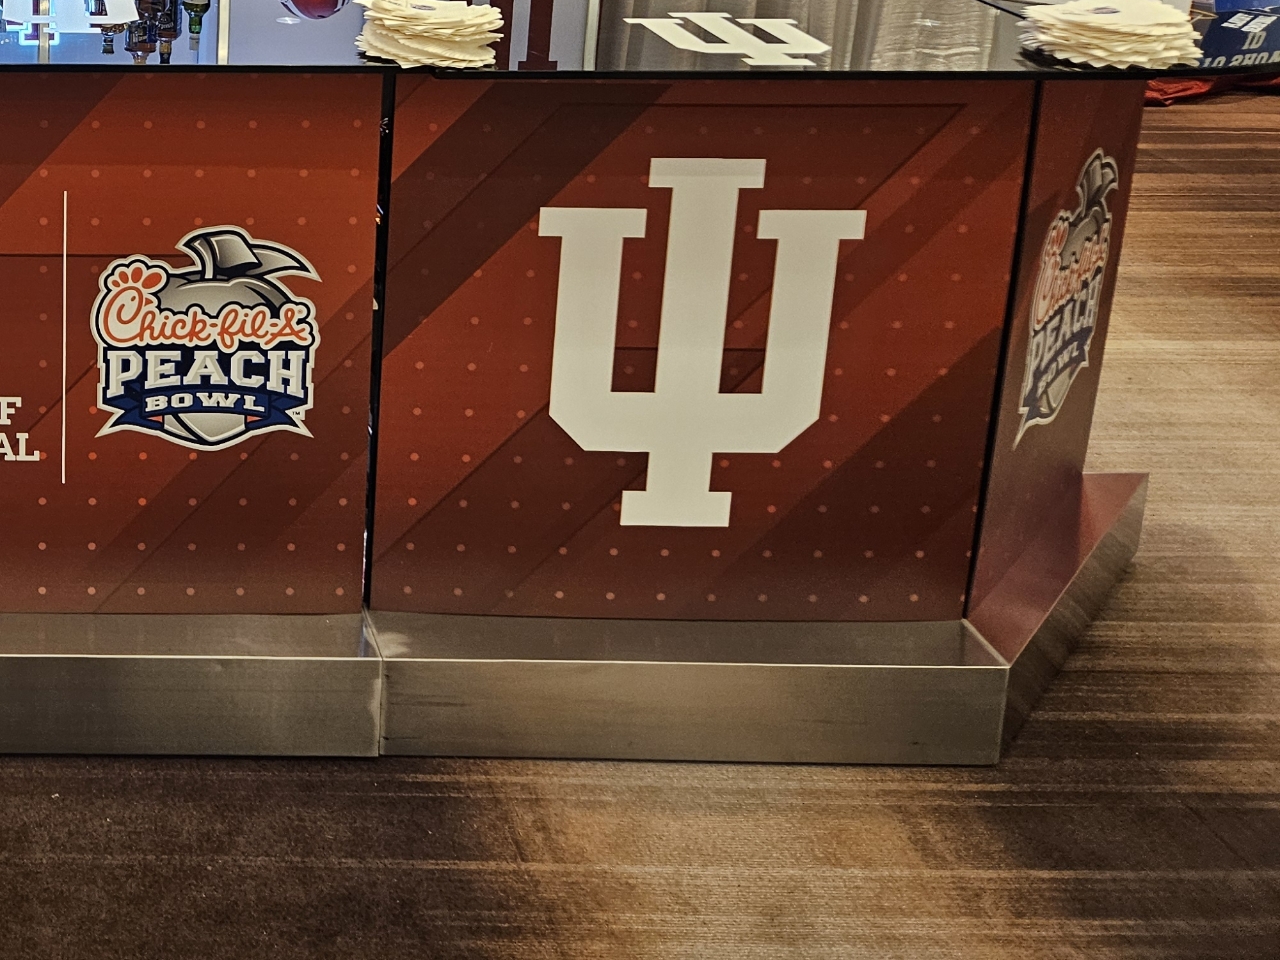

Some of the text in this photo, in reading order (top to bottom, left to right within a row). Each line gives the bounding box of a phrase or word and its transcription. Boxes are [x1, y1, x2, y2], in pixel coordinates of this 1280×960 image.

[102, 285, 308, 350] Chick-fil-A
[1025, 273, 1102, 396] PEACH
[106, 349, 307, 399] PEACH
[144, 391, 266, 413] BOWL
